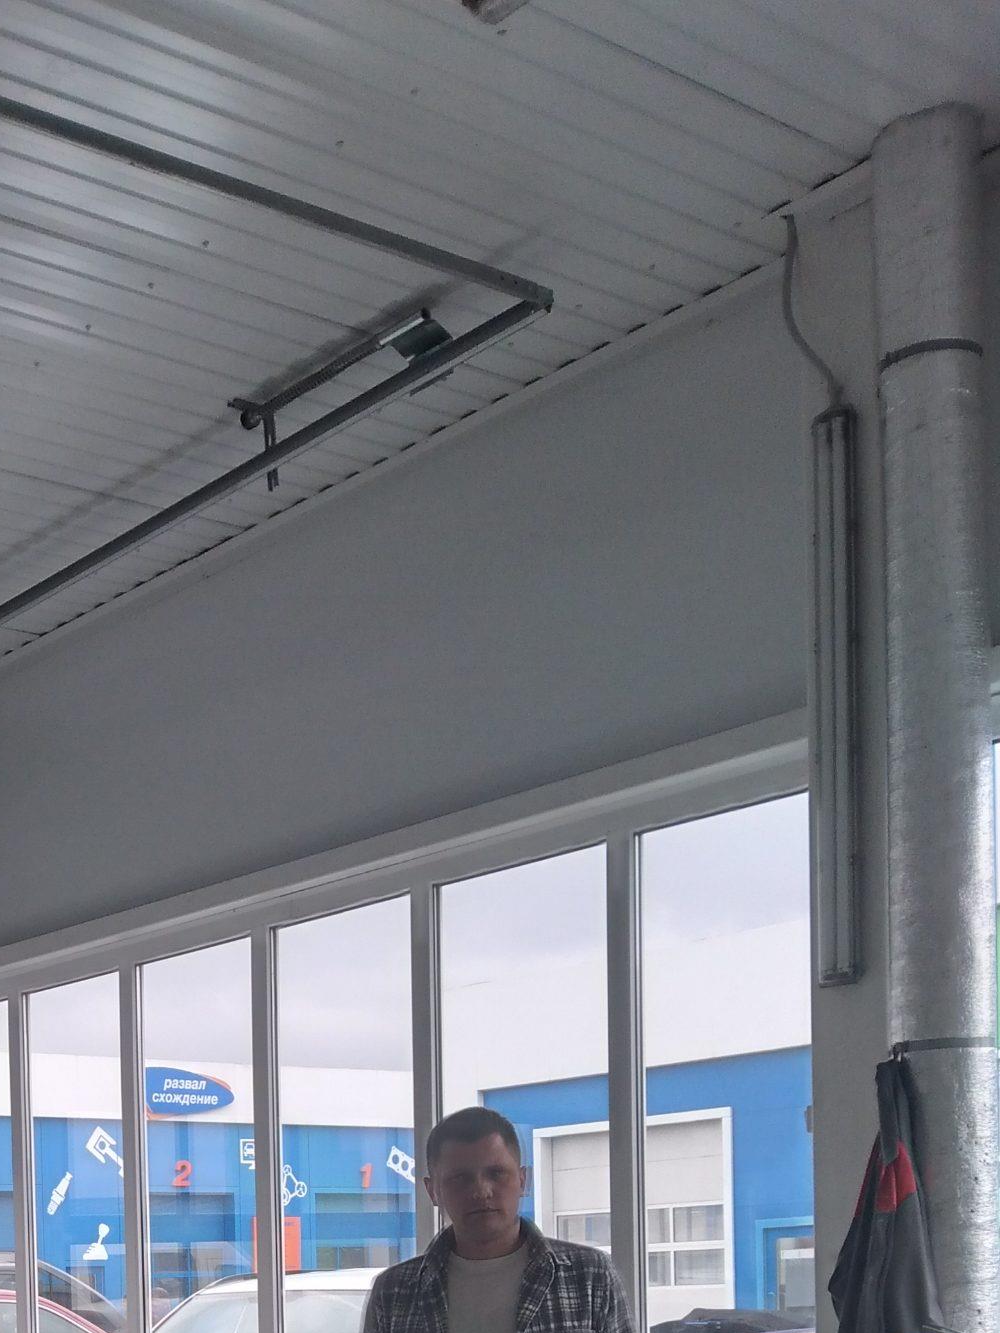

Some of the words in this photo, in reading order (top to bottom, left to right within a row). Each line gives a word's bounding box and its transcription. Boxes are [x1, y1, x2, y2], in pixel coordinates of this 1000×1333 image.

[163, 1078, 207, 1091] развал
[152, 1092, 219, 1106] схождение
[173, 1160, 192, 1187] 2
[360, 1163, 373, 1188] 1
